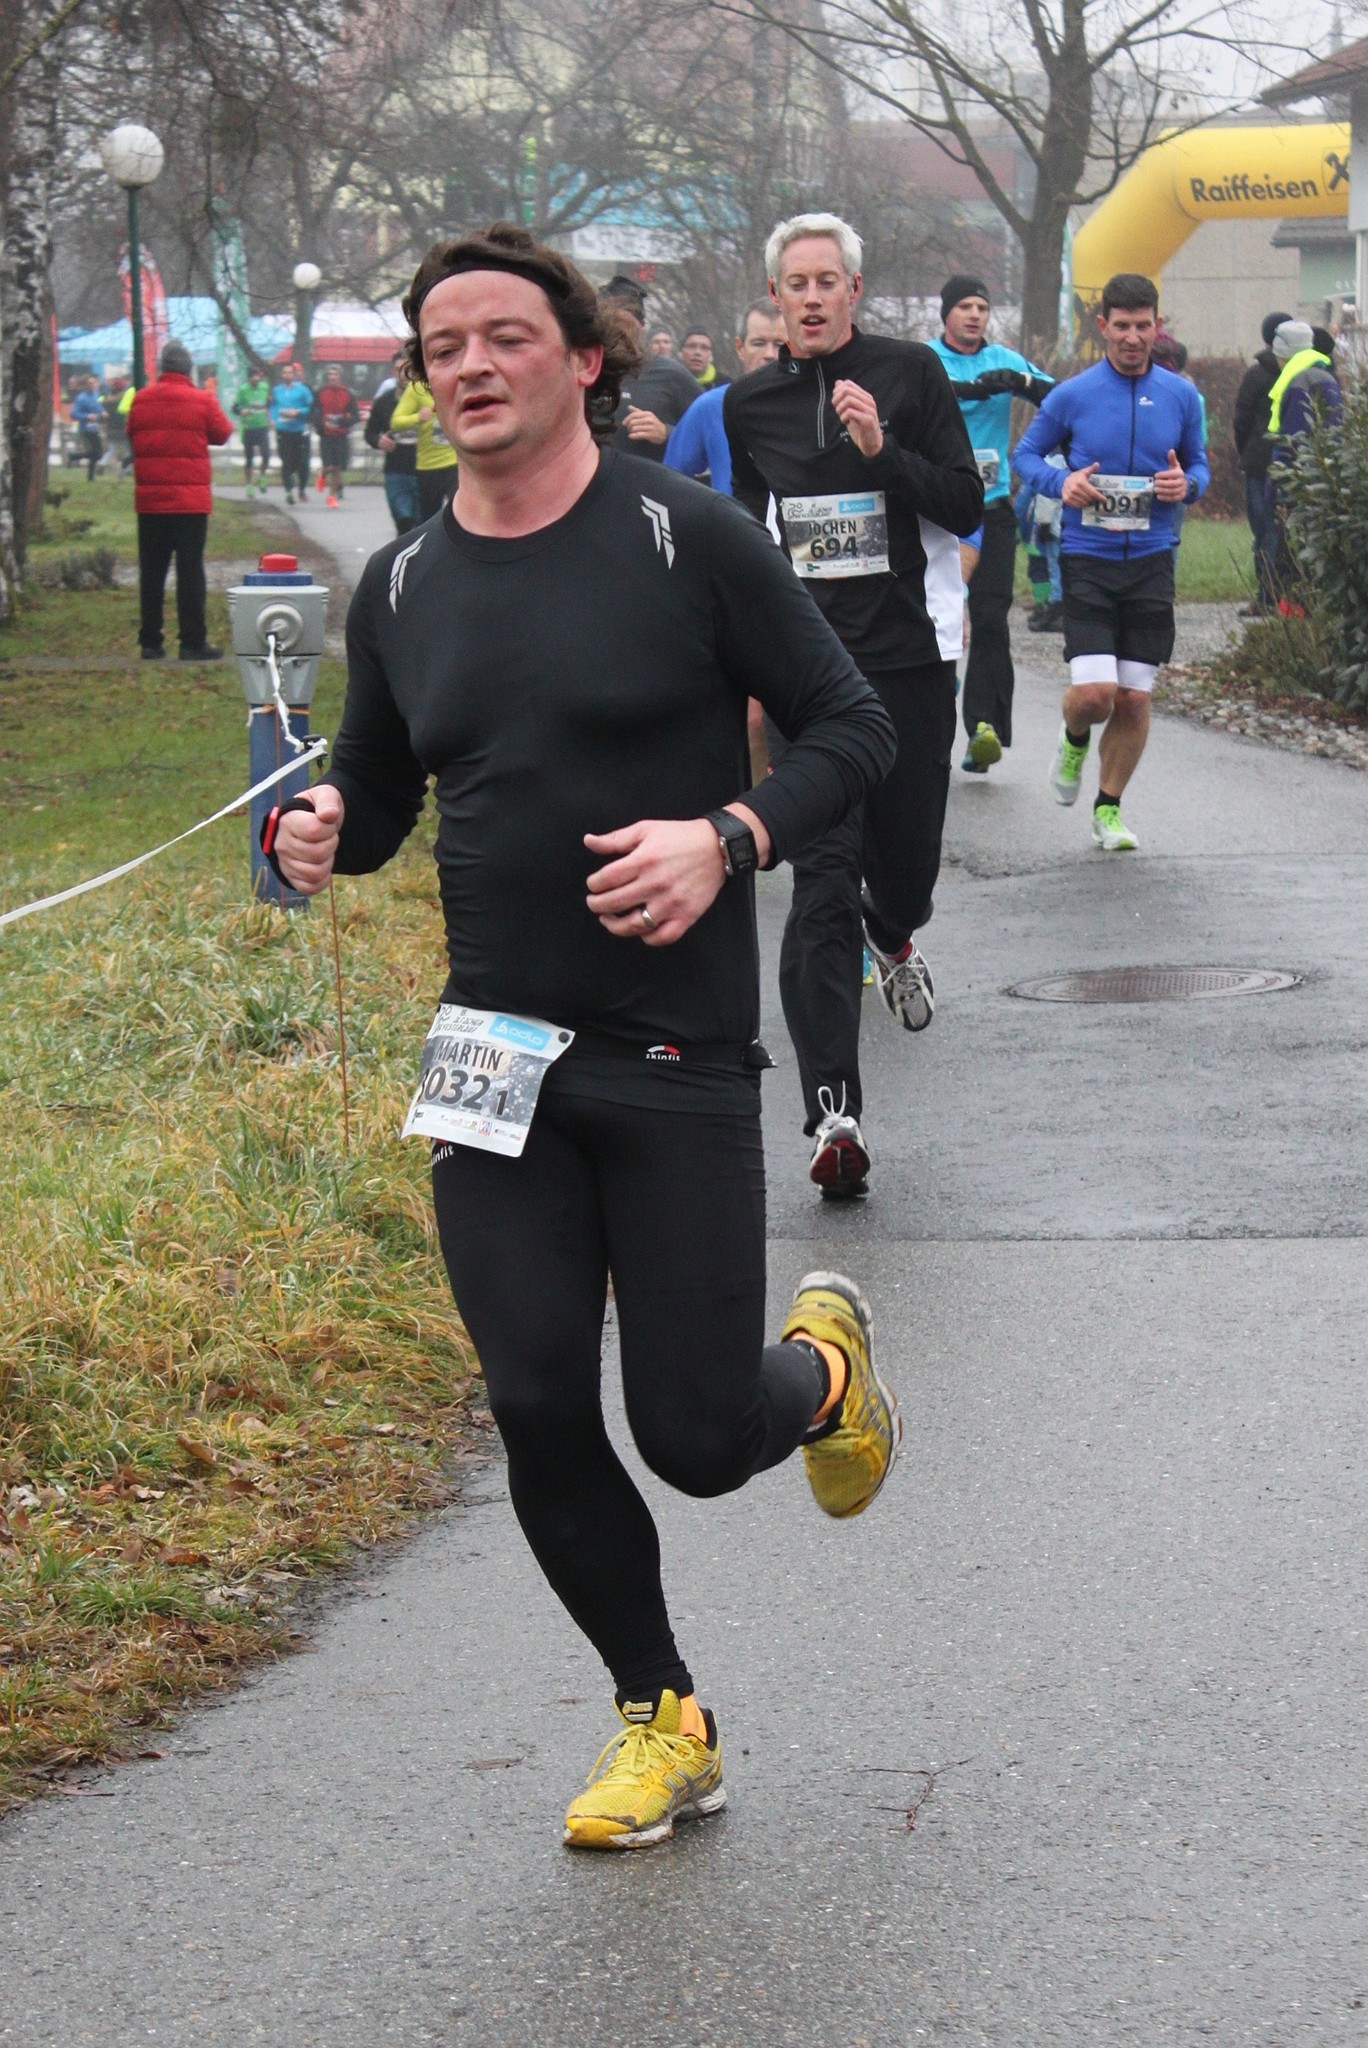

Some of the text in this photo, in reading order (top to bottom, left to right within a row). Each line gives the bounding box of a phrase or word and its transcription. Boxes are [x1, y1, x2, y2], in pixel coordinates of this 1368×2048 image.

[1190, 174, 1319, 202] Raiffeisen
[810, 536, 858, 559] 694
[434, 1040, 504, 1071] MARTIN
[646, 1053, 680, 1061] skinfit
